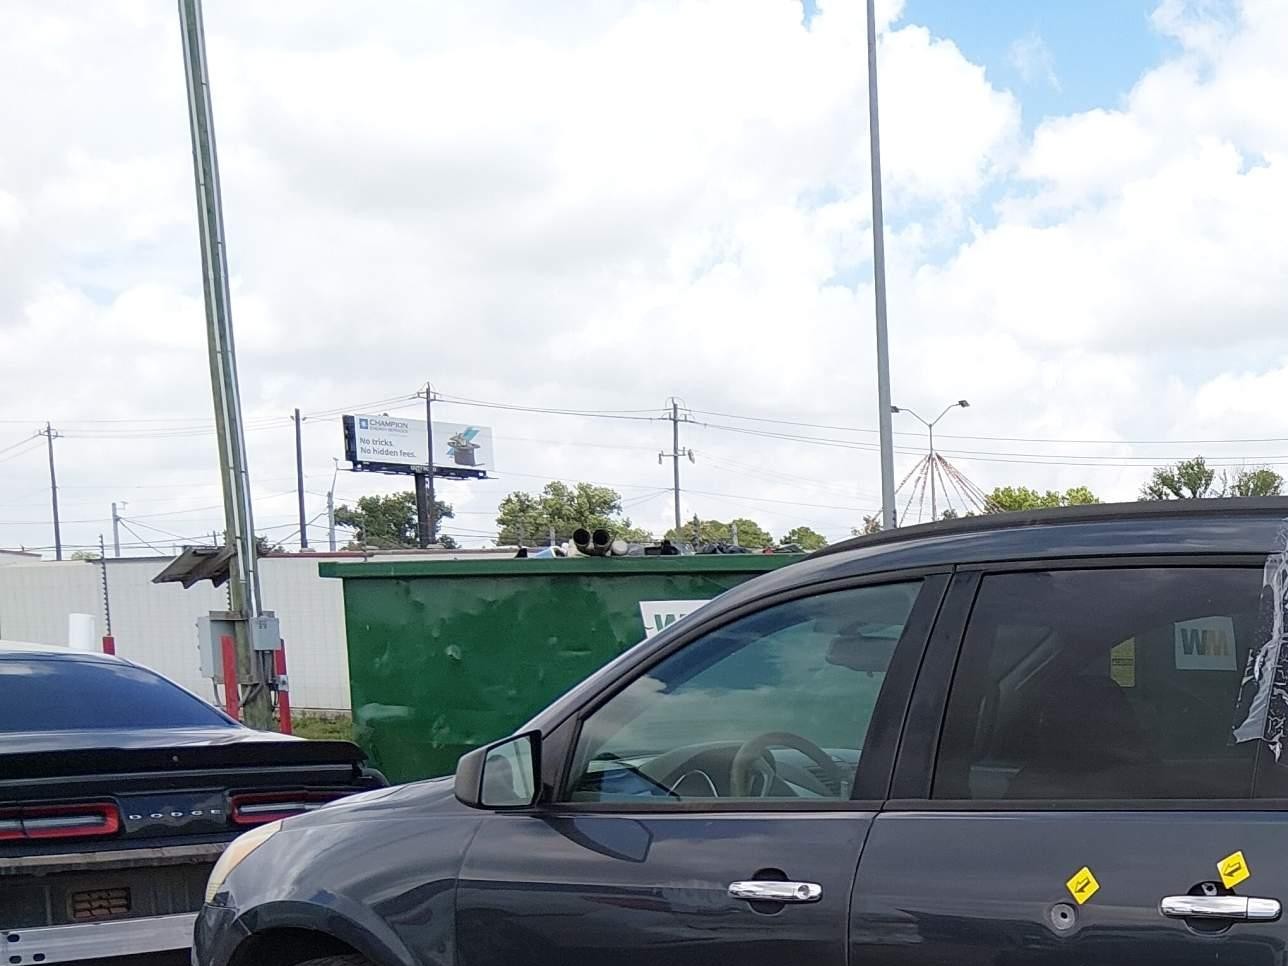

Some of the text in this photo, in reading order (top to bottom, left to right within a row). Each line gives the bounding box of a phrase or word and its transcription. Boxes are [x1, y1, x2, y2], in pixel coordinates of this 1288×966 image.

[369, 419, 409, 429] CHAMPION
[360, 437, 371, 445] No
[360, 446, 371, 454] No
[372, 447, 399, 456] hidden
